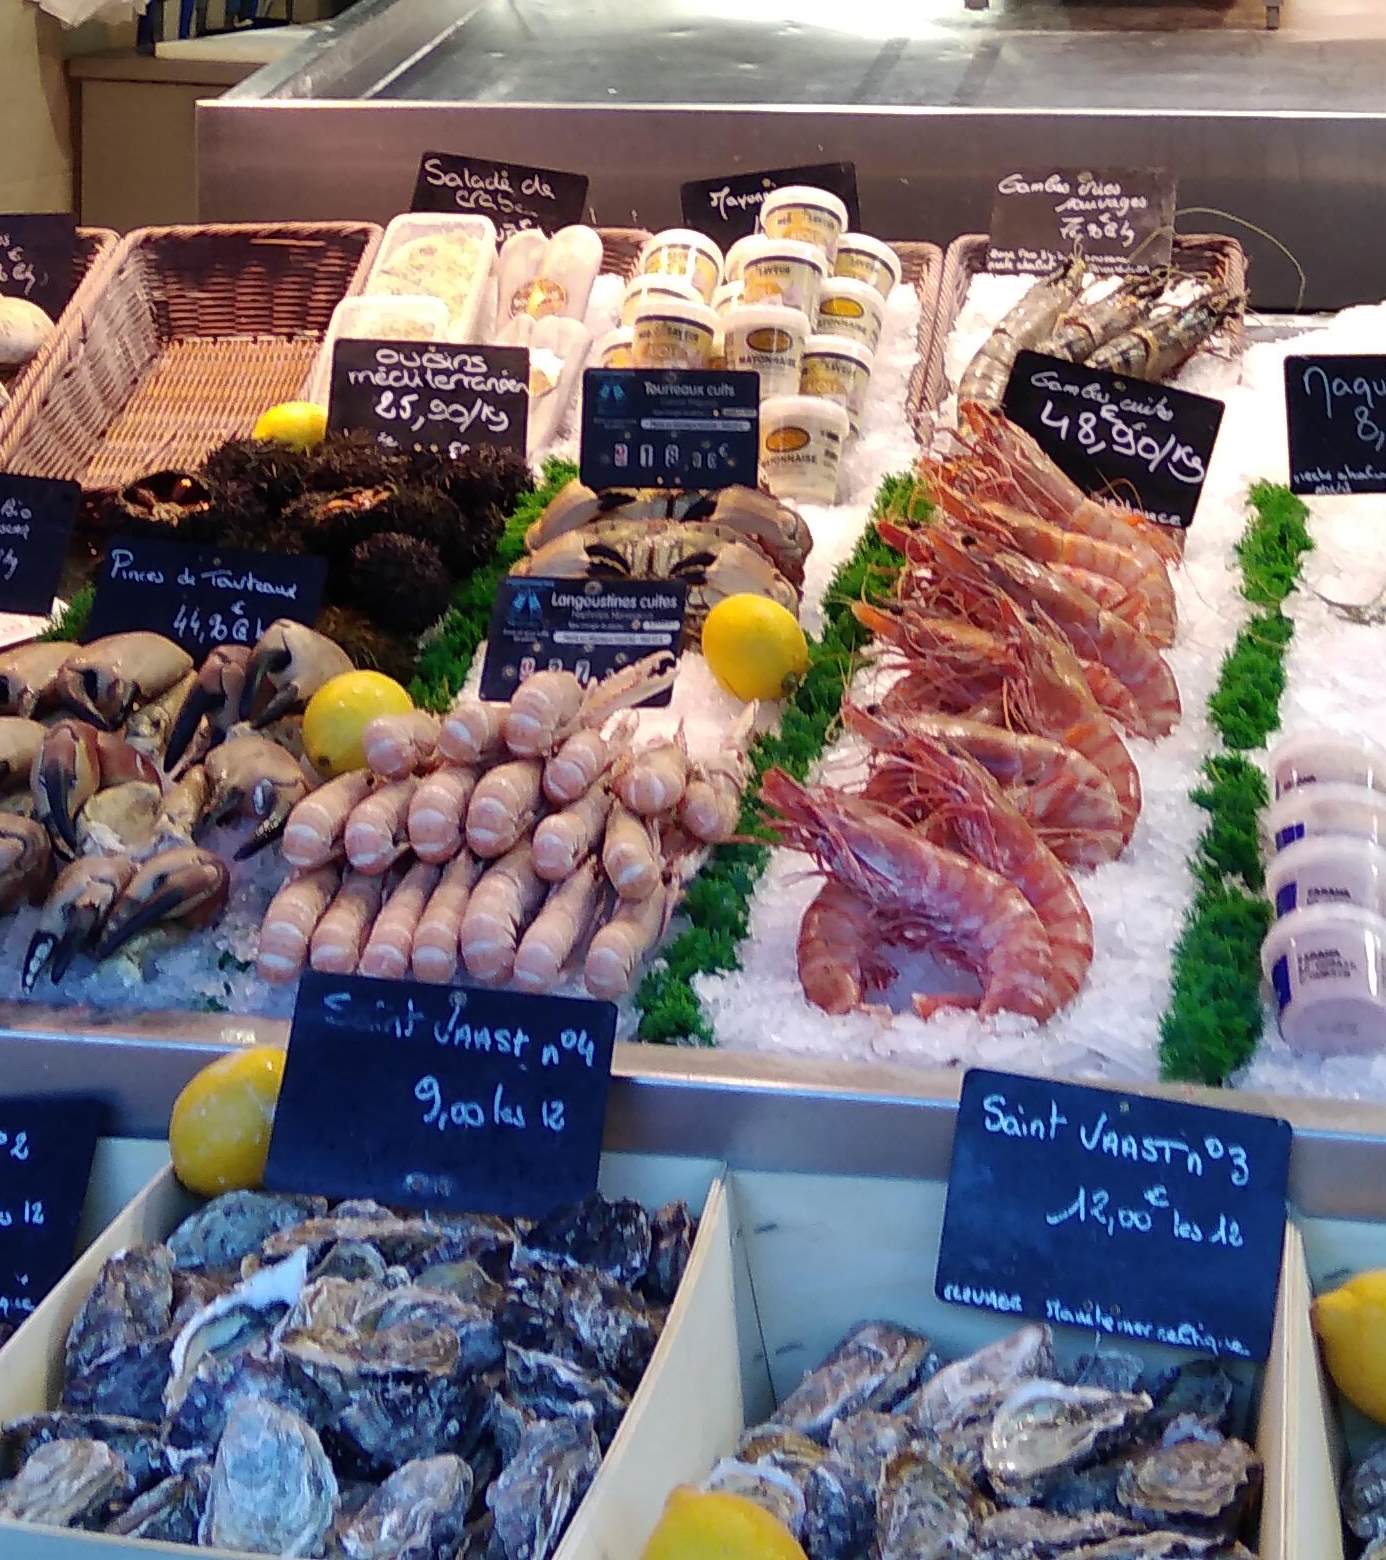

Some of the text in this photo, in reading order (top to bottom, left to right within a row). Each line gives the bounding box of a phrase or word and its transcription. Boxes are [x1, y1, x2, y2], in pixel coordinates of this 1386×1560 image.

[520, 173, 556, 201] de
[706, 382, 736, 397] cuits
[176, 567, 197, 587] de
[551, 591, 679, 611] Langoustines cuites
[493, 1082, 527, 1130] les
[541, 1099, 566, 1132] 12
[982, 1093, 1068, 1140] Saint
[23, 1199, 46, 1226] 12
[1172, 1208, 1204, 1243] les
[1209, 1212, 1245, 1247] 12
